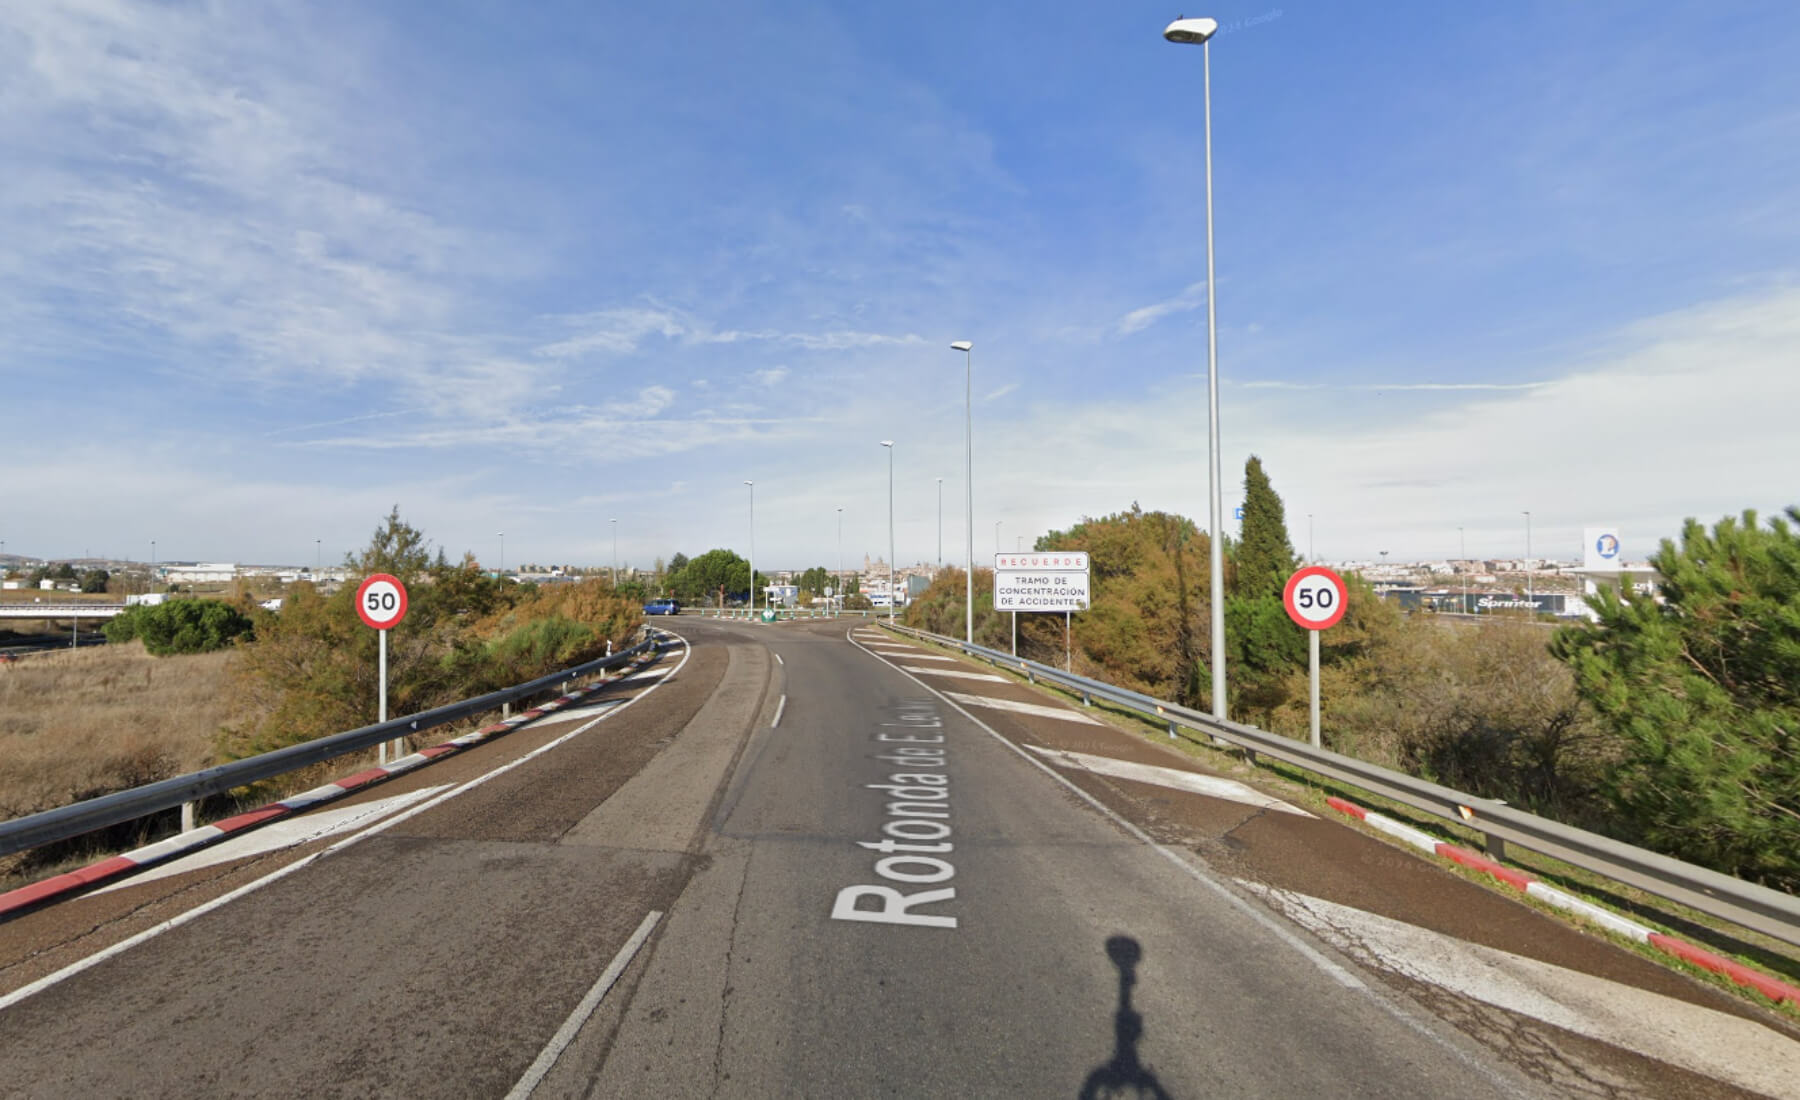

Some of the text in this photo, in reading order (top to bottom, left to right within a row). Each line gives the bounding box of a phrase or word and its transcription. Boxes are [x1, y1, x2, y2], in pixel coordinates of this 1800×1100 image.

[1001, 558, 1082, 566] RECUERDE
[1015, 577, 1067, 585] TRAMO DE
[999, 587, 1085, 596] CONCENTRACIÓN
[367, 592, 396, 611] 50
[1001, 598, 1014, 606] DE
[1299, 588, 1333, 609] 50
[1478, 598, 1542, 608] Sprinter
[875, 747, 945, 766] de
[831, 773, 957, 928] Rotonda
